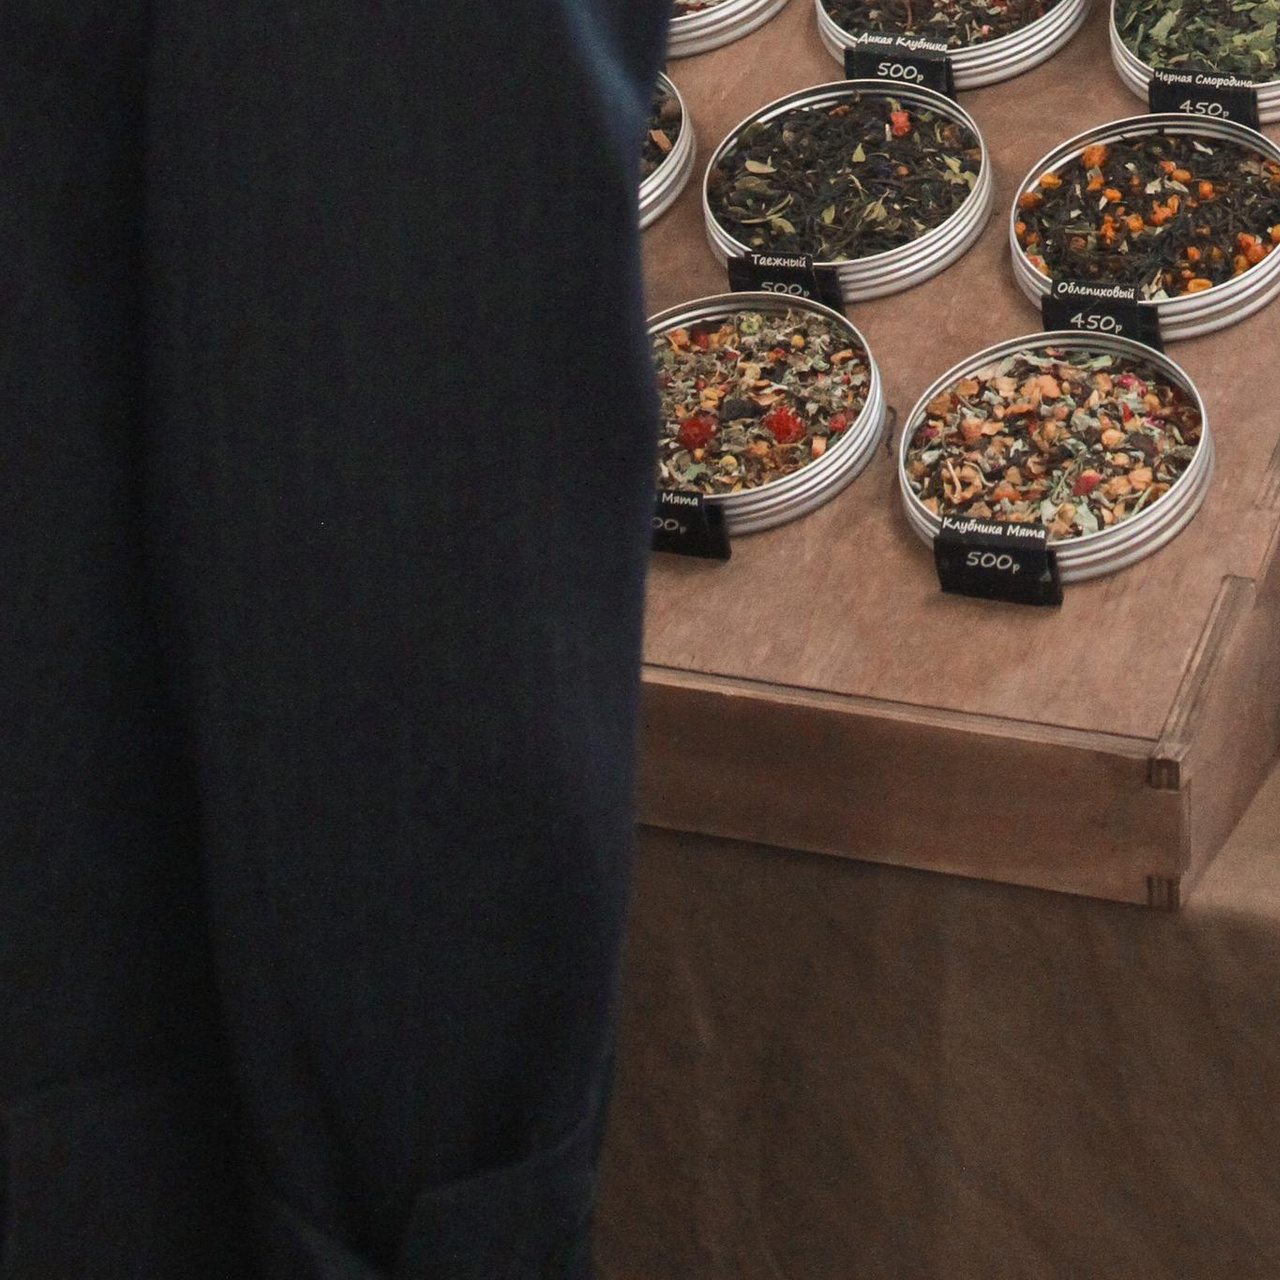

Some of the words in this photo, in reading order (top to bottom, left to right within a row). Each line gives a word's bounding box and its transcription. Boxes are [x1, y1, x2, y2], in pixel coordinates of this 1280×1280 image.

[857, 32, 893, 45] Дикая
[896, 36, 948, 52] Клубника
[1155, 71, 1192, 85] Черная
[1195, 74, 1253, 89] Смородина
[751, 254, 806, 268] Таежный
[1057, 282, 1135, 299] Облепиховый
[661, 492, 698, 507] Мята
[943, 517, 1002, 535] Клубника
[1007, 524, 1045, 539] Мята
